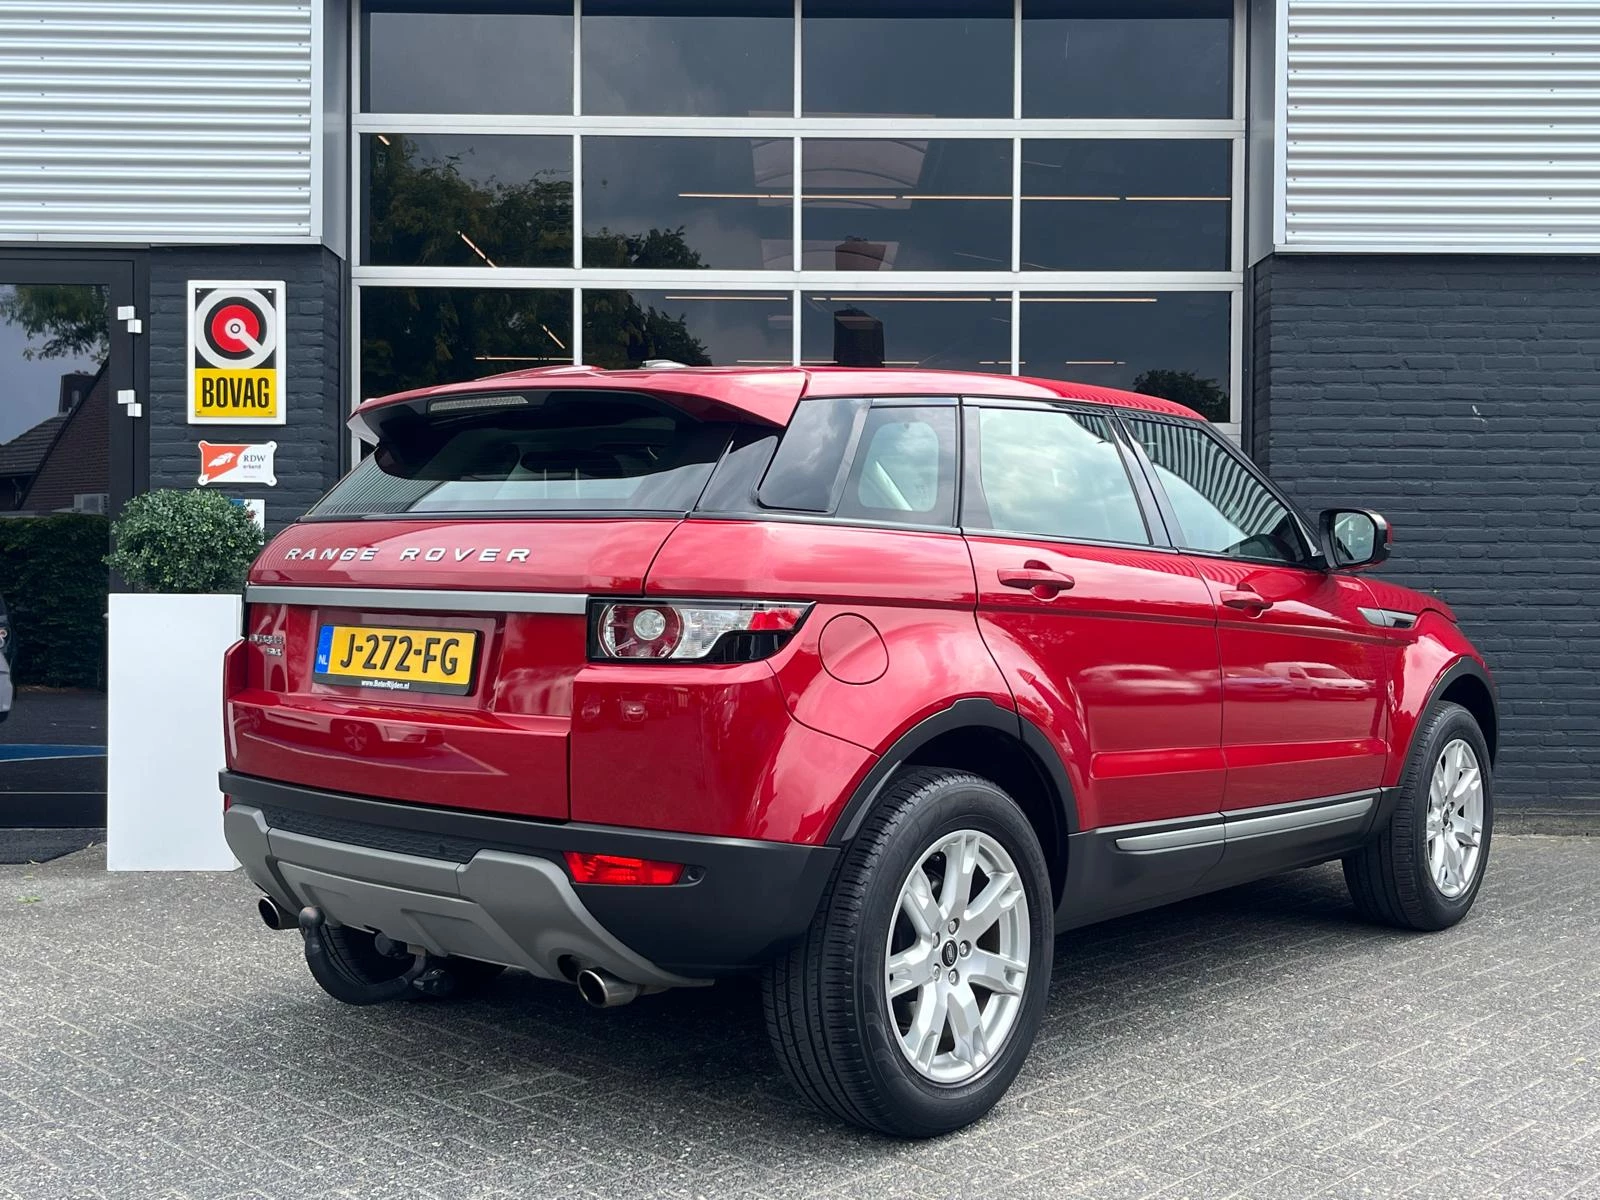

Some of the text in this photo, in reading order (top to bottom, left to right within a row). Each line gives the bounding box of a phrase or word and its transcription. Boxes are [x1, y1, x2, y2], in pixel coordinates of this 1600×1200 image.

[202, 377, 270, 408] BOVAG
[243, 454, 266, 462] RDW
[284, 547, 531, 562] RANGE ROVER
[318, 633, 459, 676] NL J-272-FG
